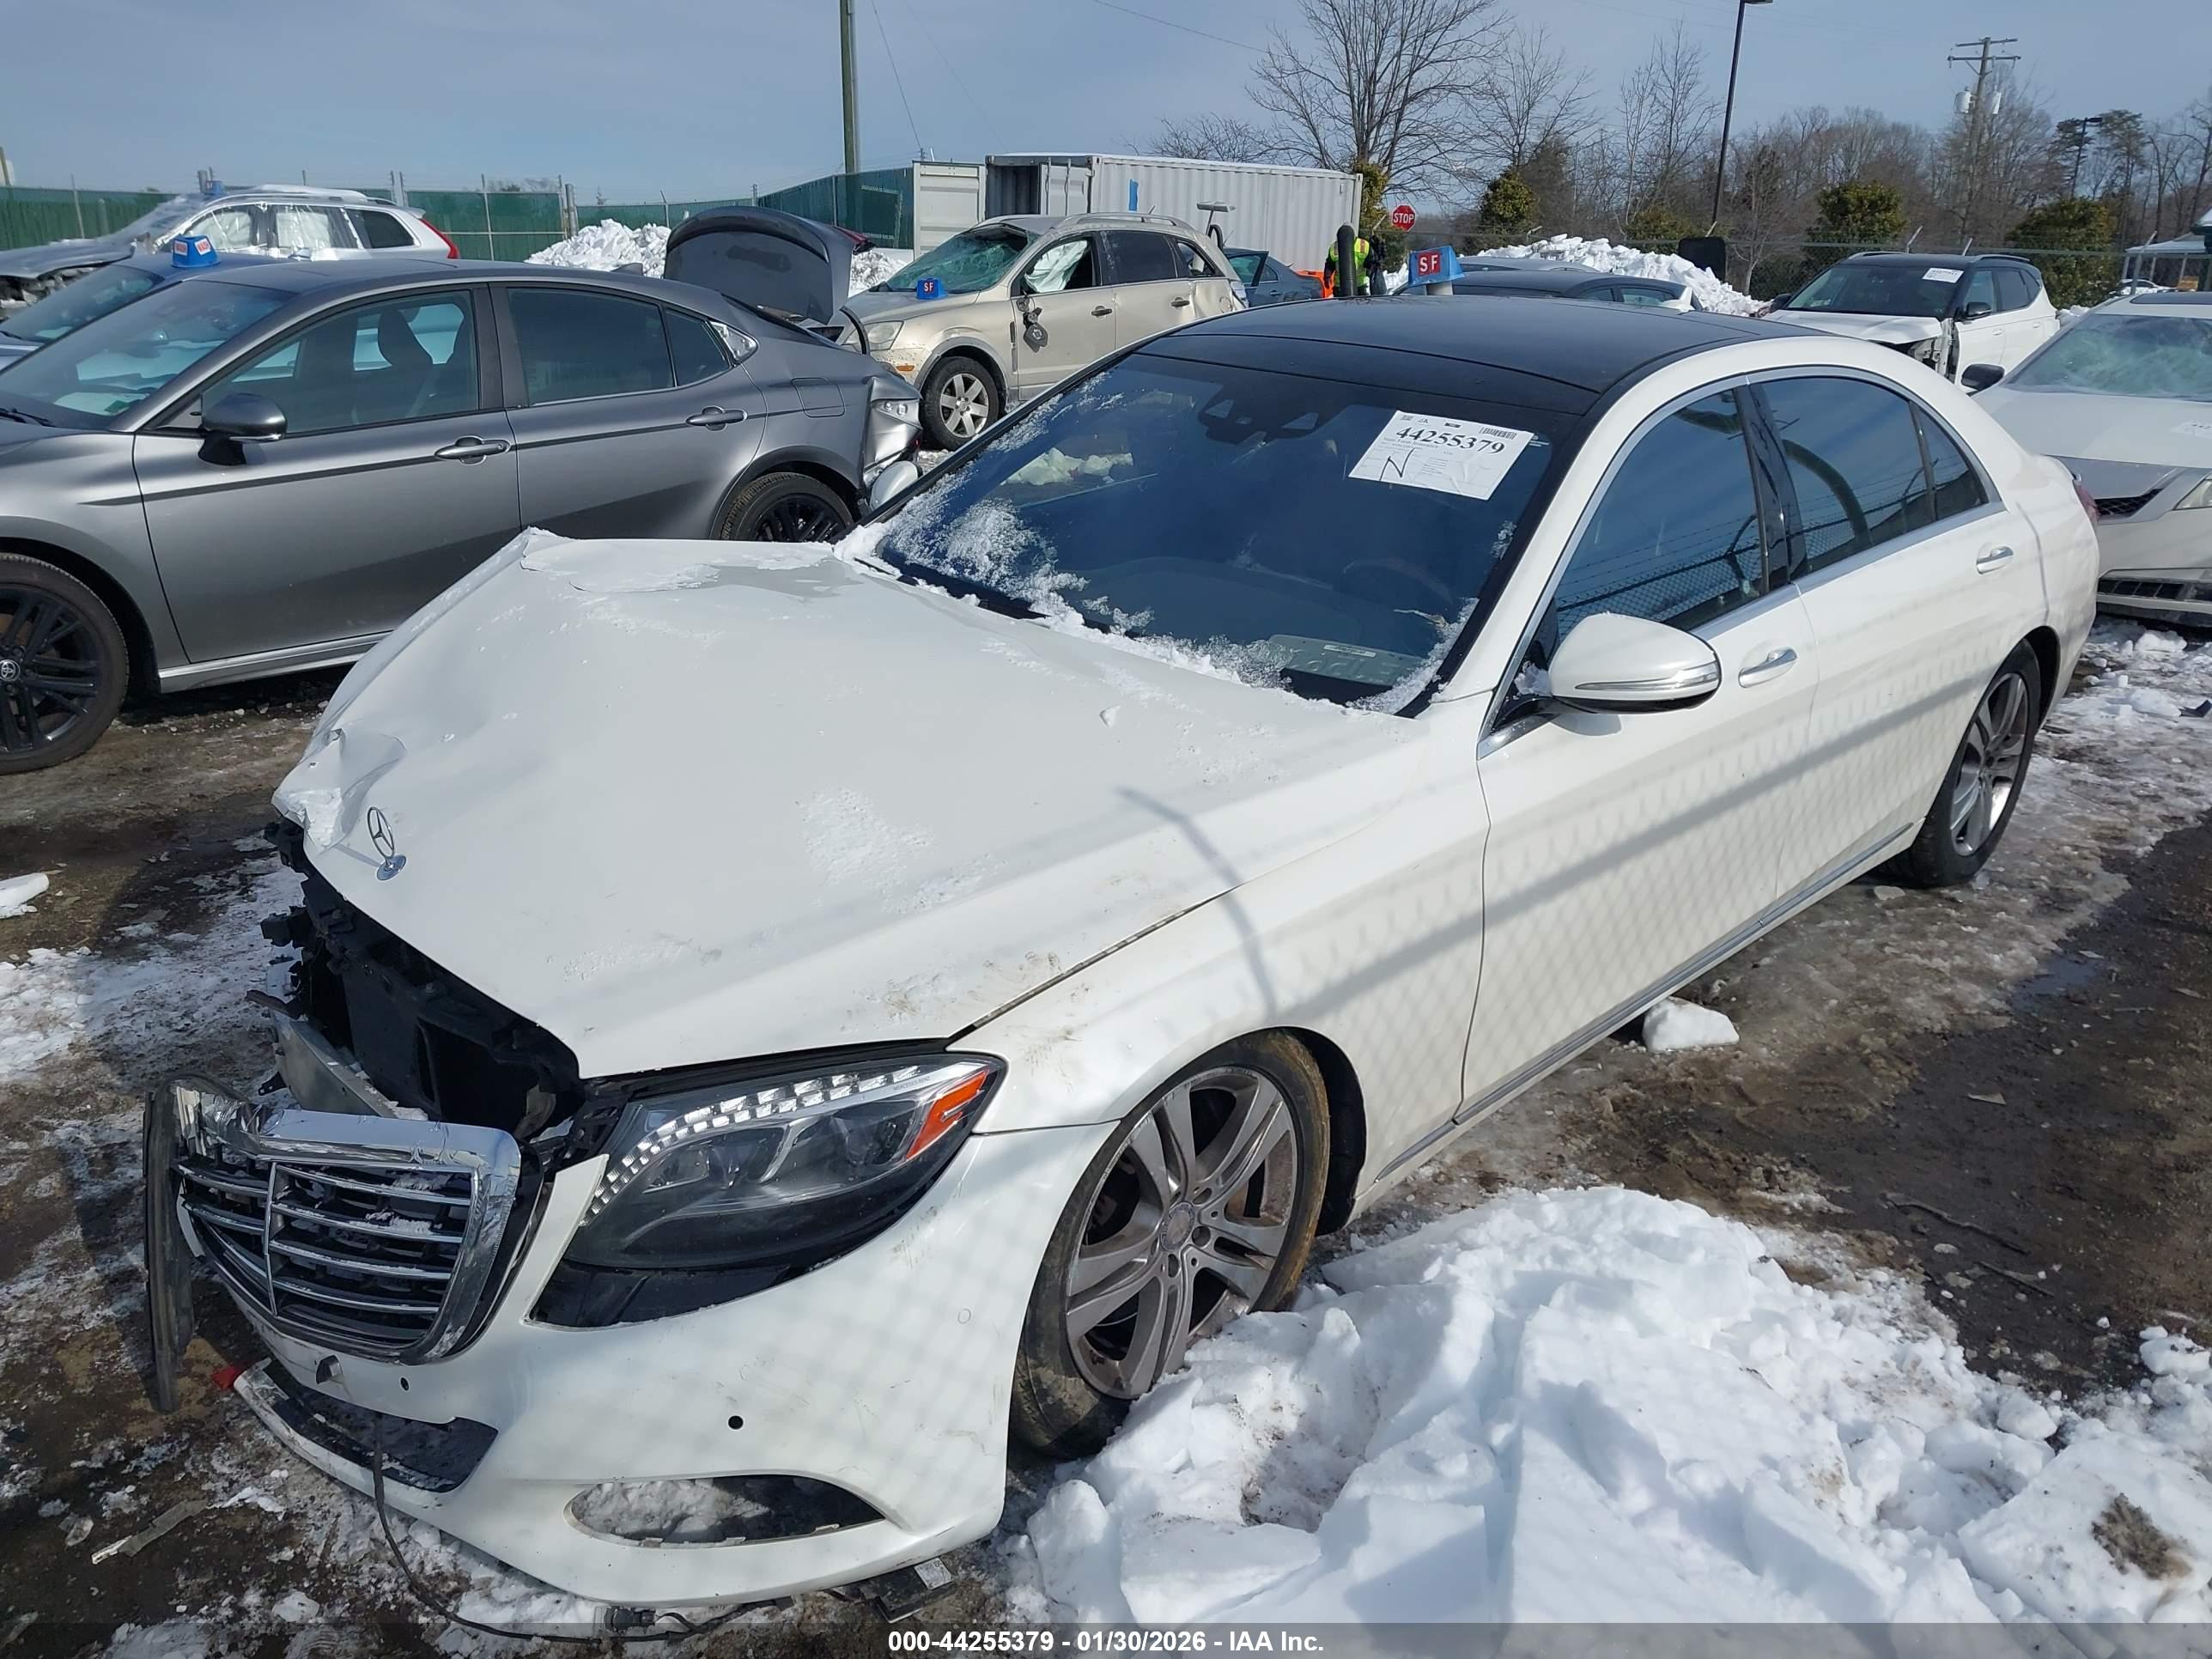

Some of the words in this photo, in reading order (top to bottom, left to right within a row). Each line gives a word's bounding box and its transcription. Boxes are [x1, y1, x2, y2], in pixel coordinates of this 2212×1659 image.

[1393, 212, 1414, 223] STOP
[1396, 427, 1505, 453] 44255379
[1379, 447, 1415, 482] N
